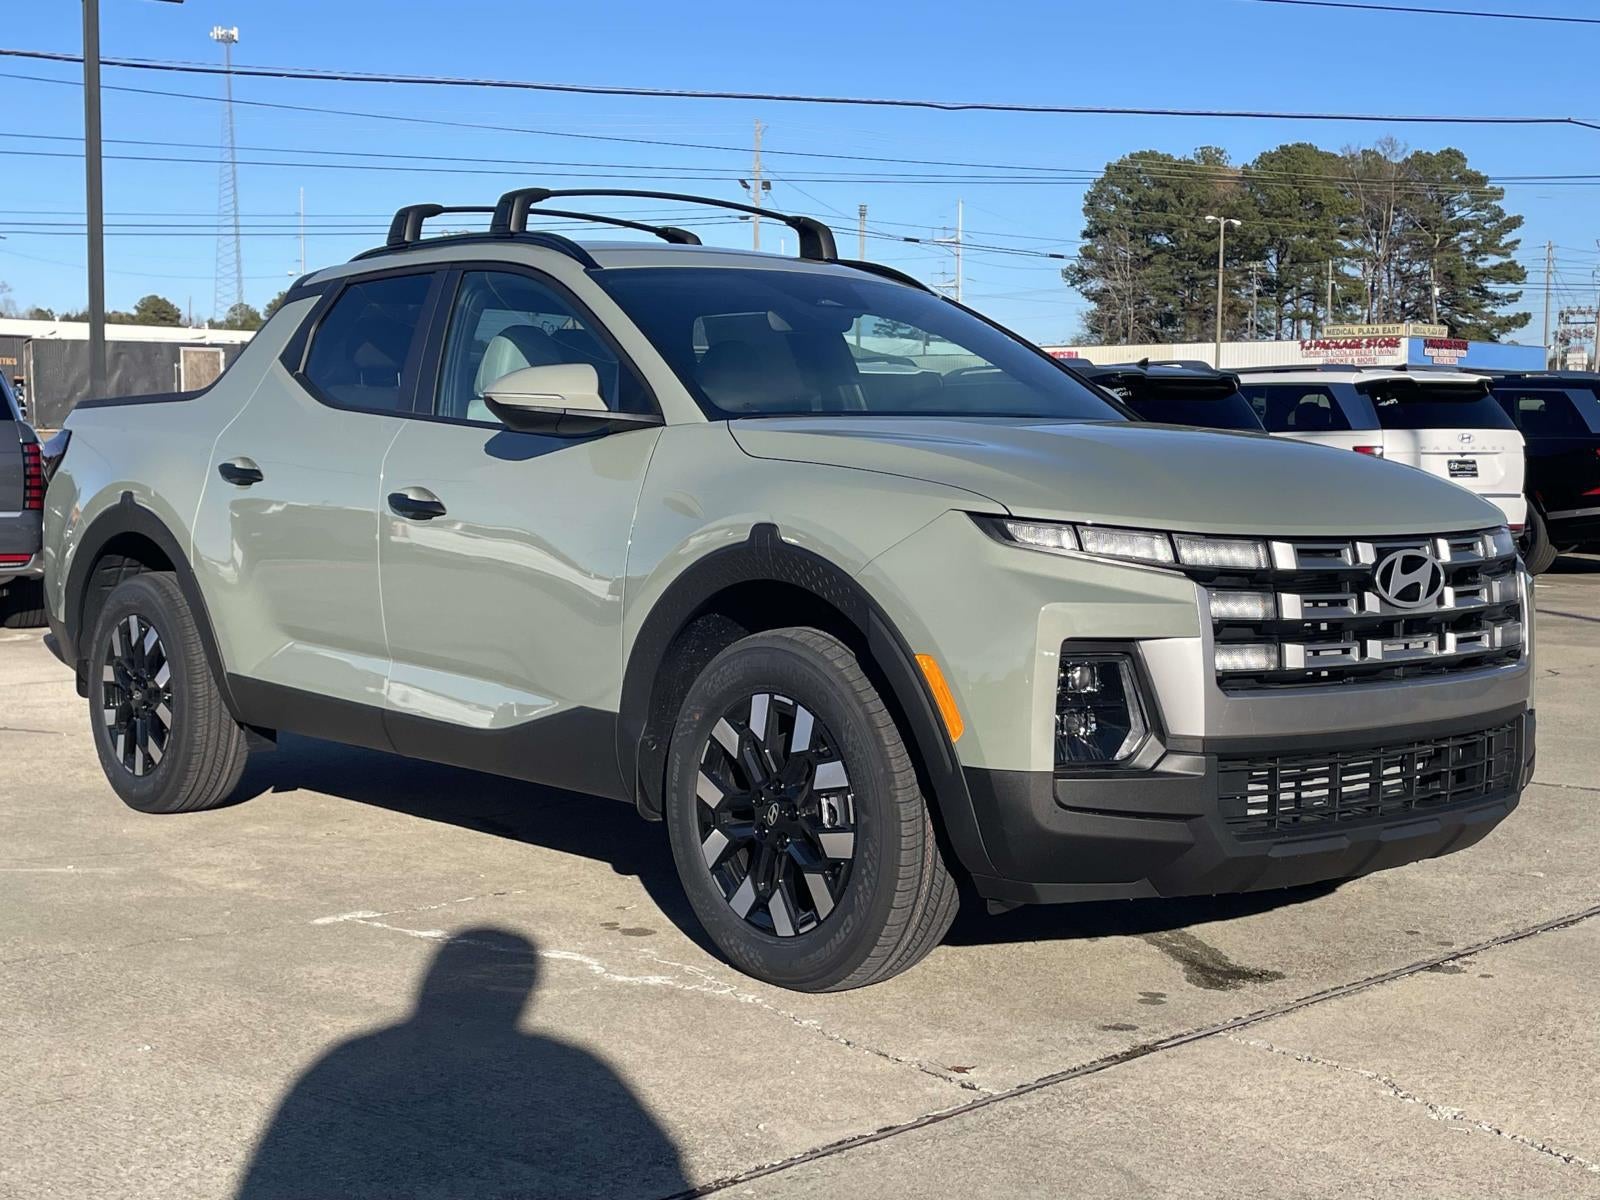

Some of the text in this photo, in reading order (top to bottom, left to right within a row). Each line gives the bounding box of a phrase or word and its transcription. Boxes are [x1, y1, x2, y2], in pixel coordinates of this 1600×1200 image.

[1326, 326, 1401, 336] MEDICAL PLAZA EAST
[1313, 338, 1362, 350] PACKAGE
[1365, 336, 1402, 349] STORE
[1304, 350, 1330, 358] SPIRITS
[1355, 349, 1373, 357] BEER
[1377, 348, 1396, 356] WINE
